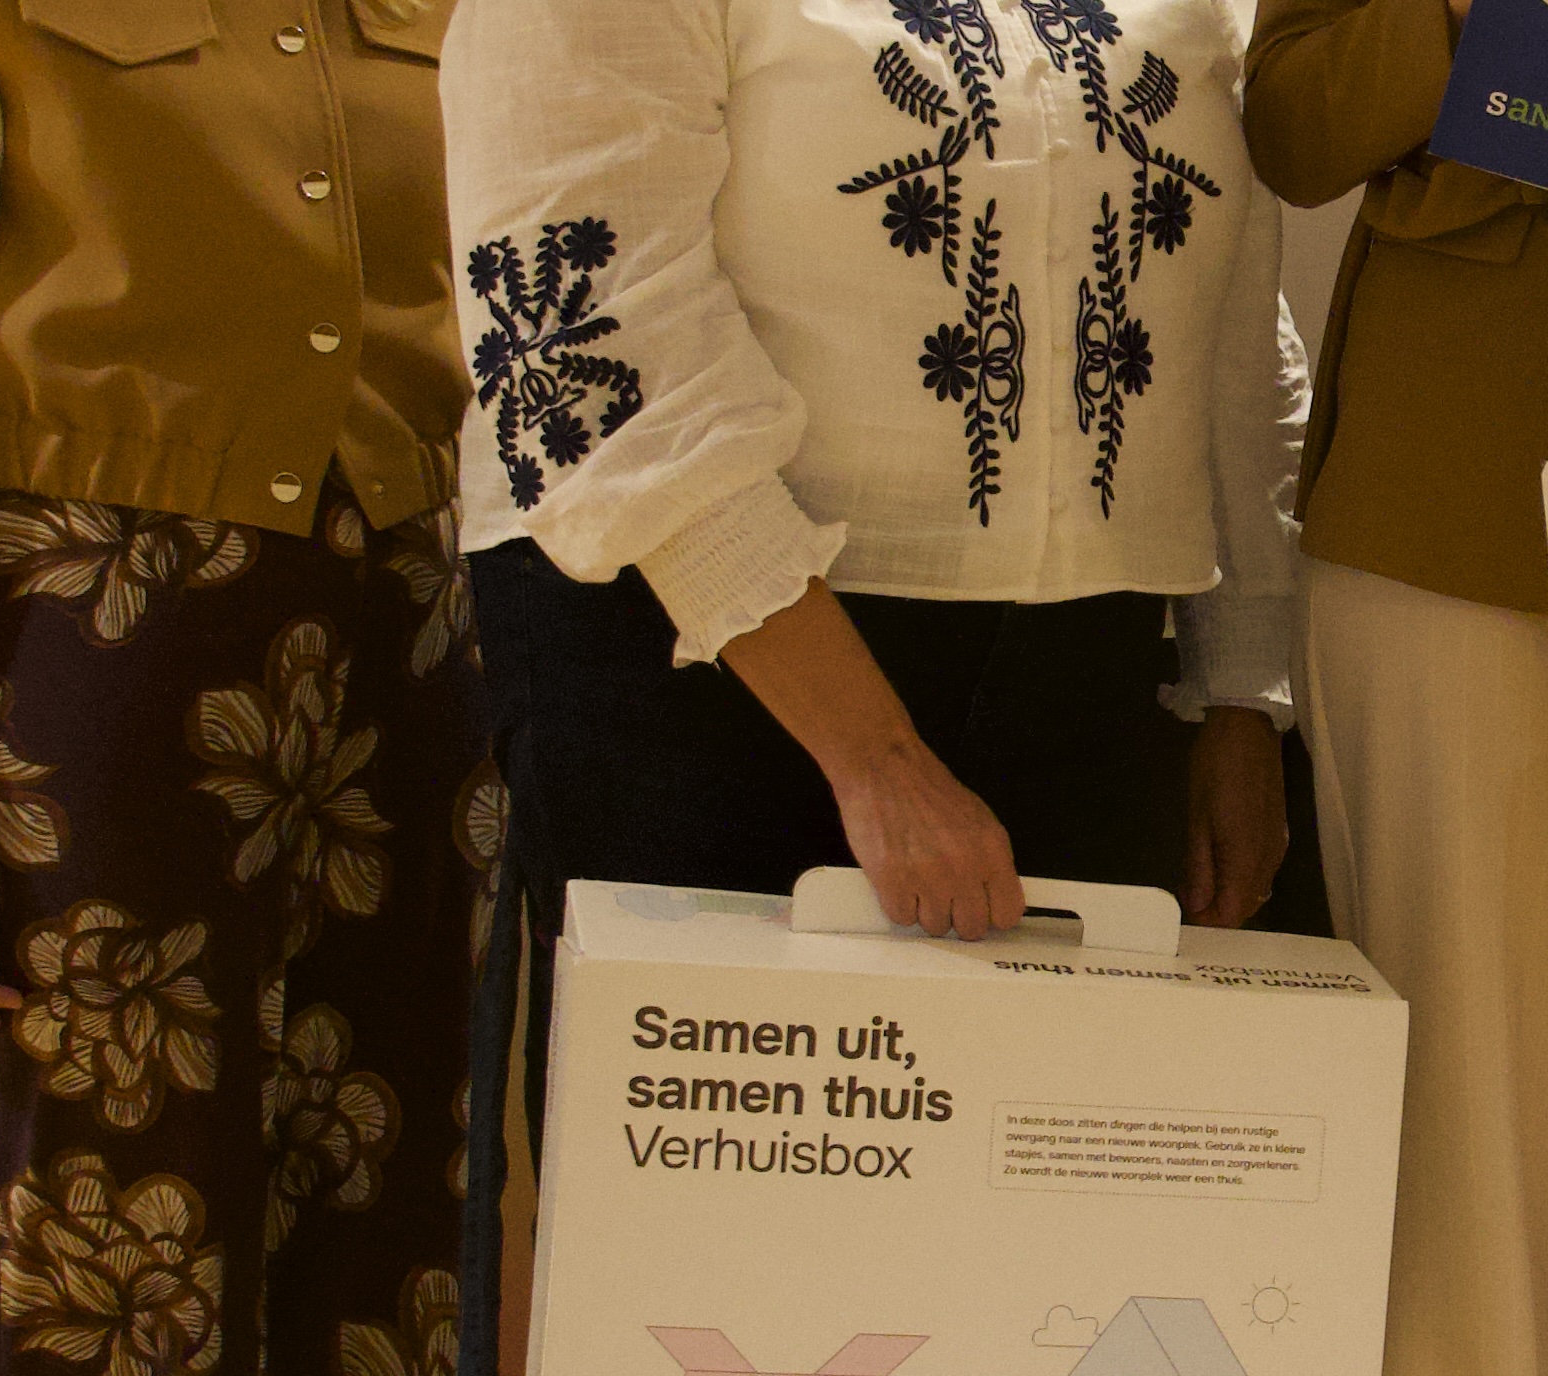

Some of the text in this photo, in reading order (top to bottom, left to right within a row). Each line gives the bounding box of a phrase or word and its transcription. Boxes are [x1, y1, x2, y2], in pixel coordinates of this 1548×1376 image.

[993, 959, 1076, 976] thuis
[1084, 966, 1192, 982] samen
[1194, 963, 1366, 984] Verhuisbox
[1262, 978, 1372, 993] Samen
[632, 1005, 917, 1070] Samen uit,
[626, 1075, 954, 1122] samen thuis
[1007, 1115, 1279, 1139] In deze doos zitten dingen die helpen bij een rustige
[624, 1124, 914, 1180] Verhuisbox
[1005, 1132, 1306, 1154] overgang naar een nieuwe woonplek. Gebruik ze in kleine
[1004, 1148, 1046, 1160] stapjes,
[1048, 1151, 1083, 1161] samen
[1086, 1152, 1106, 1162] met
[1108, 1153, 1165, 1165] bewoners,
[1167, 1156, 1209, 1167] naasten
[1211, 1159, 1225, 1167] en
[1003, 1164, 1017, 1175] Zo
[1020, 1165, 1052, 1176] wordt
[1054, 1167, 1068, 1177] de
[1070, 1168, 1109, 1179] nieuwe
[1111, 1170, 1163, 1182] woonplek
[1166, 1174, 1193, 1183] weer
[1195, 1175, 1215, 1184] een
